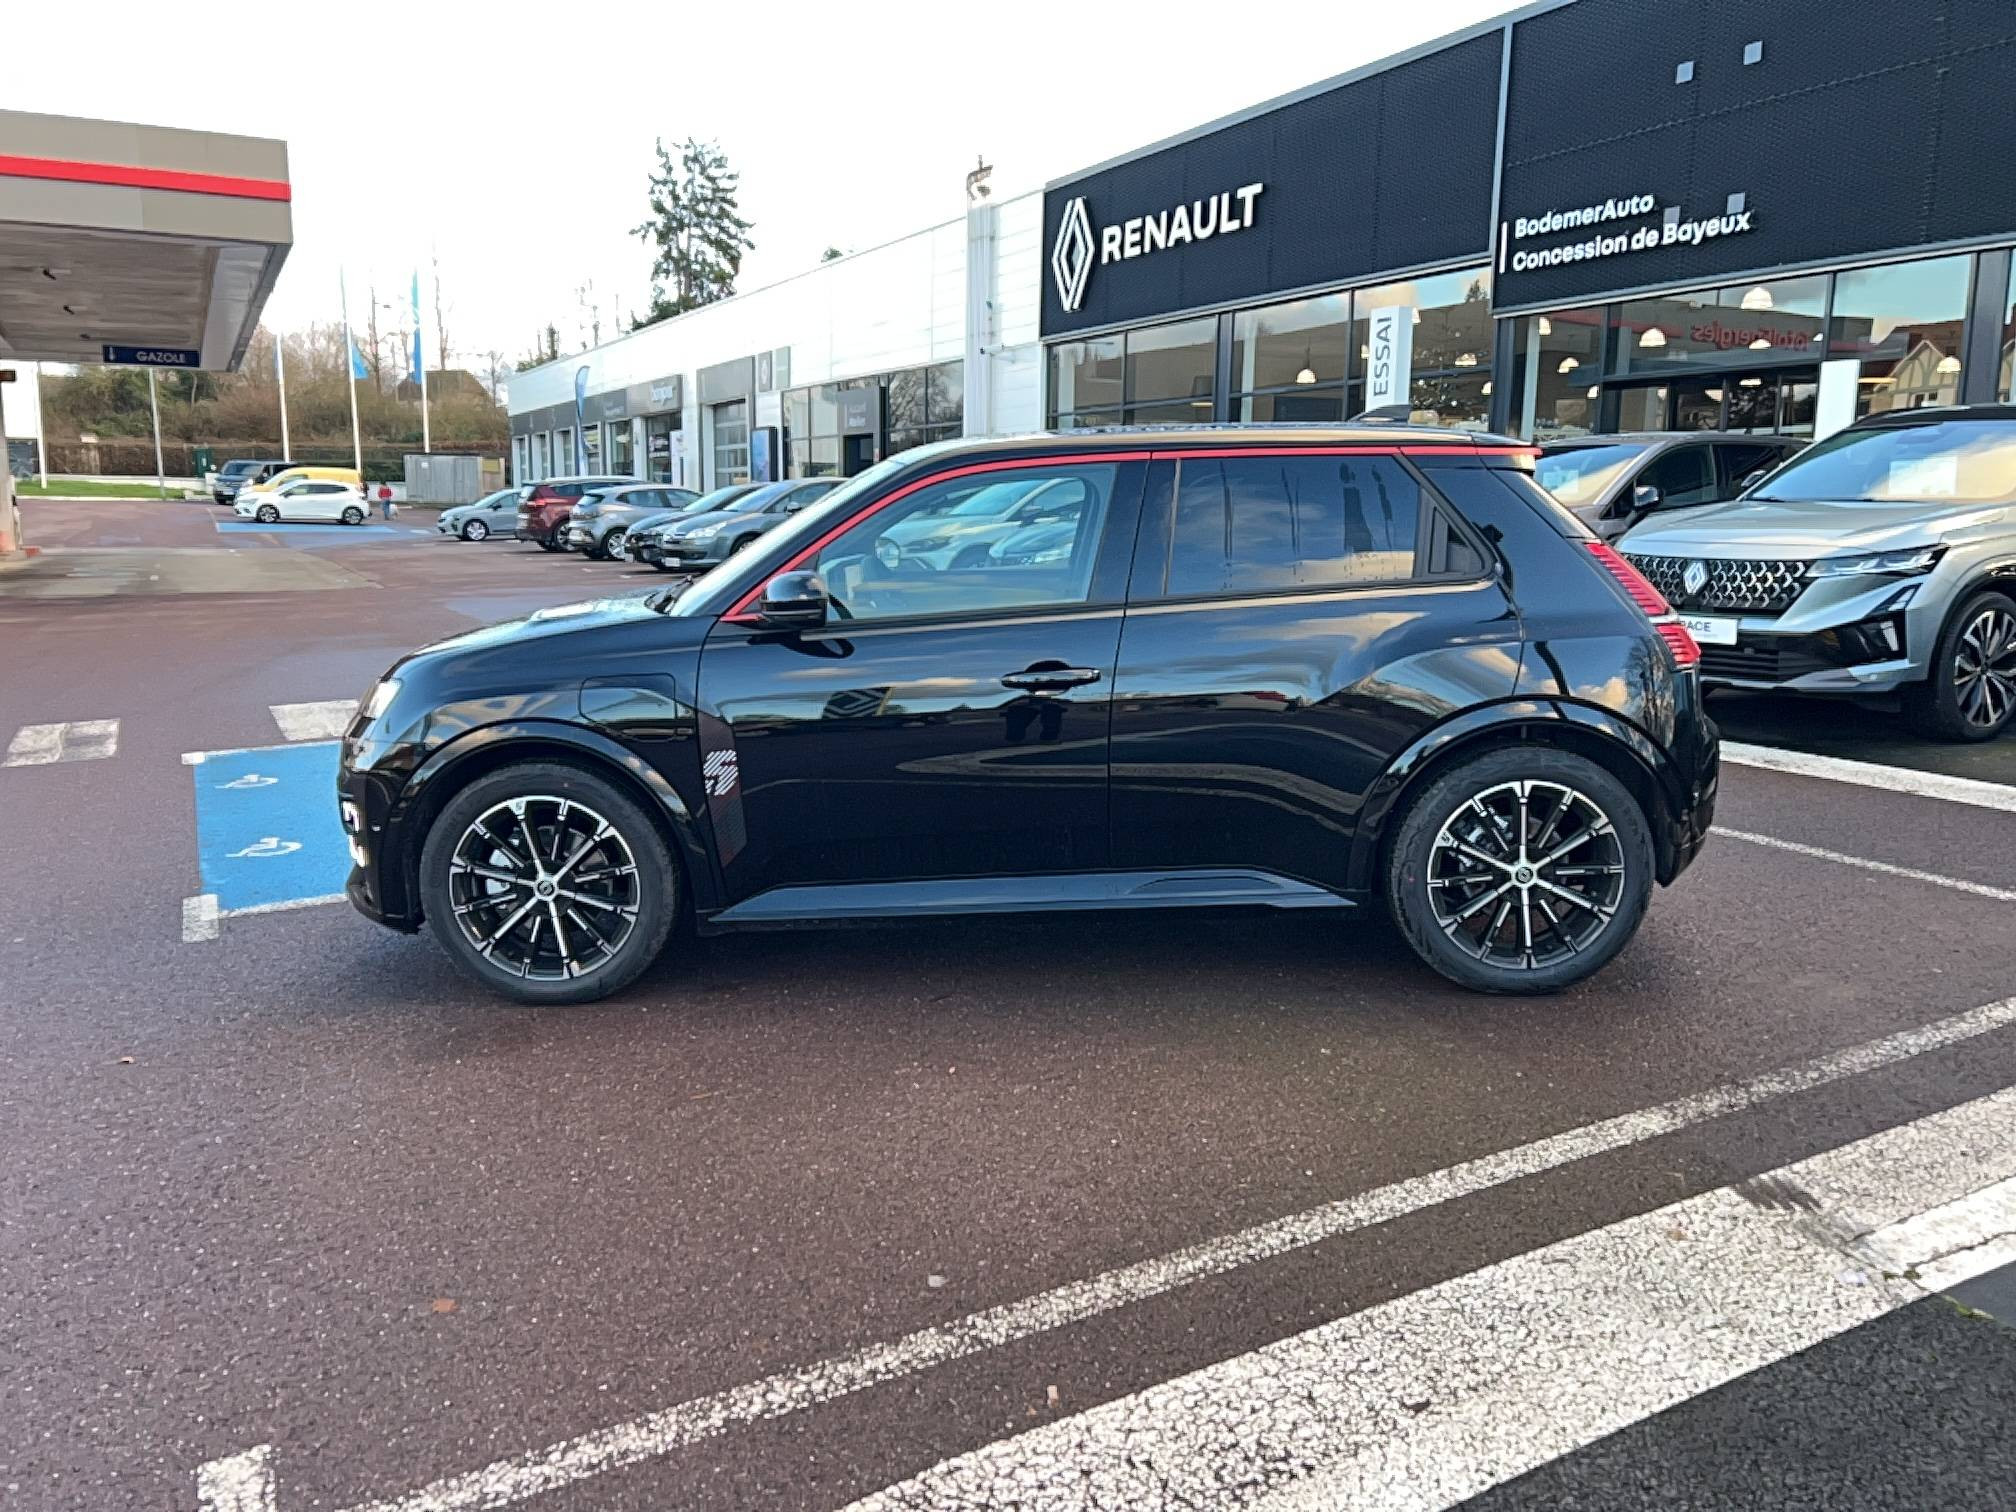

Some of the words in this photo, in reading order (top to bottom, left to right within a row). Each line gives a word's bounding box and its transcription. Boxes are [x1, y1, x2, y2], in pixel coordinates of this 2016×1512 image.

[1101, 183, 1264, 265] RENAULT
[1512, 235, 1628, 271] Concession
[1630, 227, 1659, 250] de
[1662, 211, 1751, 245] Bayeux
[1514, 193, 1656, 239] BodemerAuto
[1373, 316, 1392, 396] ESSAI
